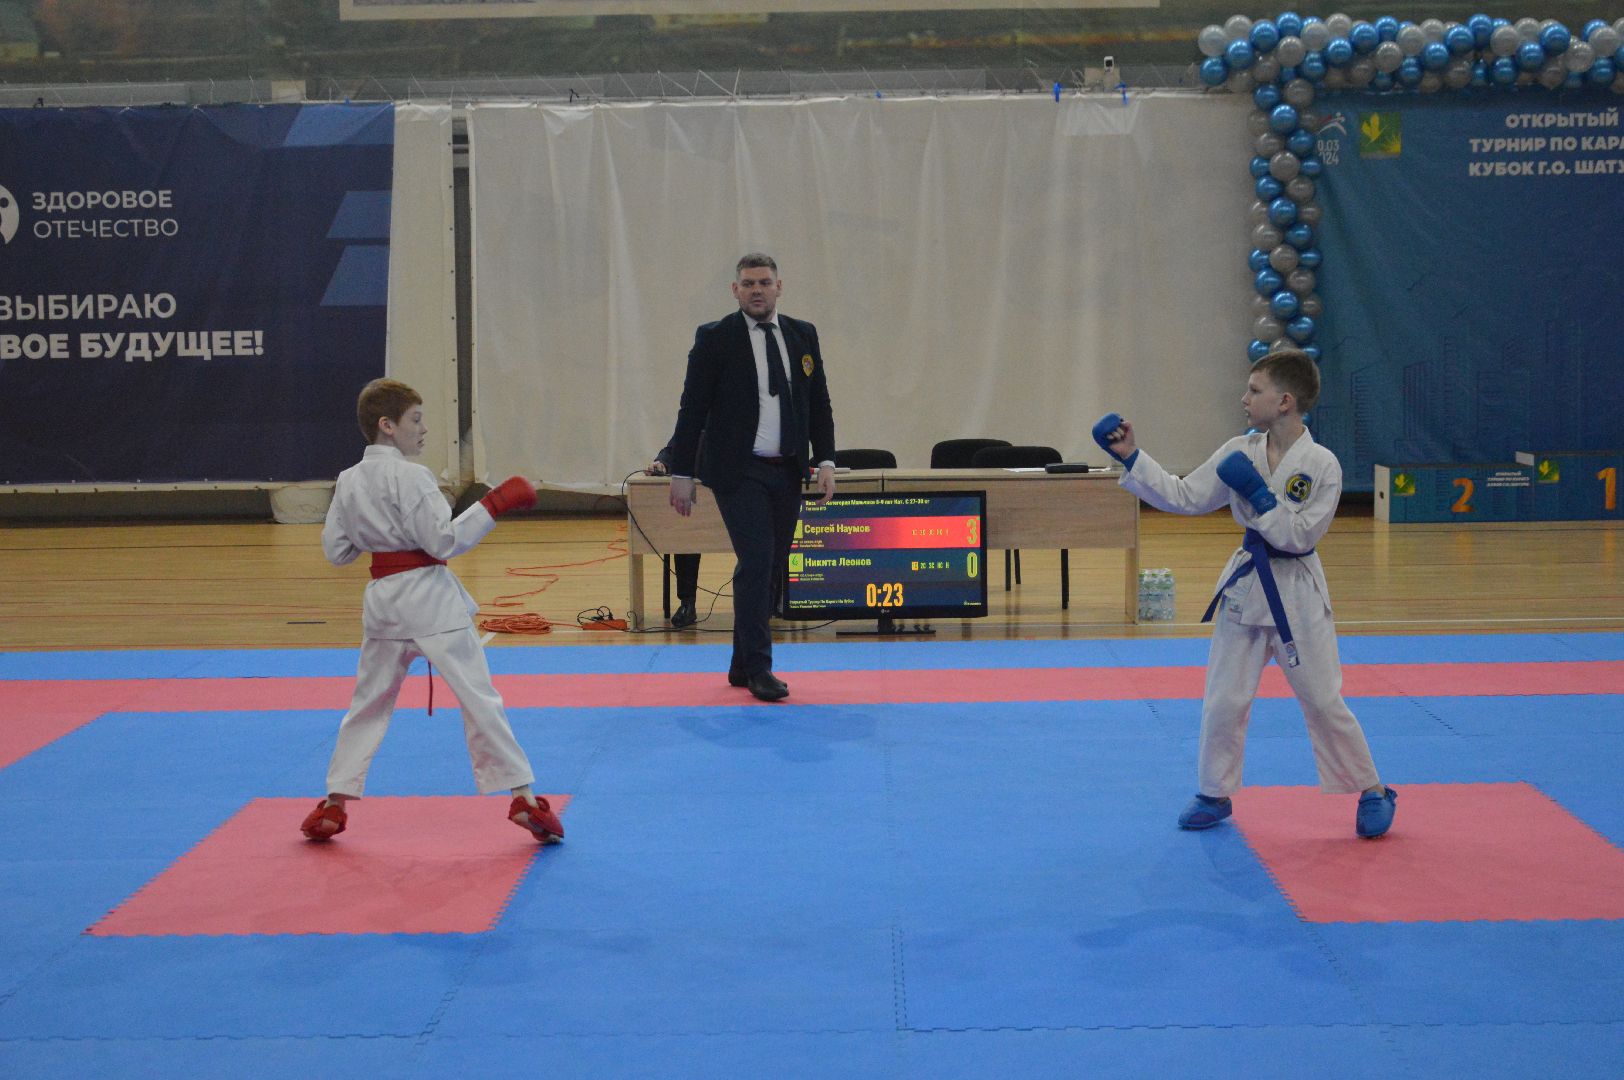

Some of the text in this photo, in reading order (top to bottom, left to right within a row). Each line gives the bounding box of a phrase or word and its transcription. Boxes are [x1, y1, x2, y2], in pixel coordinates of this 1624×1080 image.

[1505, 107, 1619, 129] ОТКРЫТЫЙ
[1469, 137, 1548, 153] ТУРНИР
[1551, 137, 1577, 152] ПО
[1469, 161, 1534, 177] КУБОК
[1537, 161, 1571, 176] Г.О.
[32, 189, 173, 213] ЗДОРОВОЕ
[33, 218, 179, 239] ОТЕЧЕСТВО
[0, 292, 177, 320] ВЫБИРАЮ
[80, 330, 264, 362] БУДУЩЕЕ!
[1452, 477, 1474, 513] 2
[1596, 467, 1617, 511] 1
[804, 523, 871, 535] Сергей Наумов
[967, 518, 977, 545] 3
[804, 557, 872, 567] Никита Леонов
[967, 551, 978, 578] 0
[866, 582, 904, 607] 0:23
